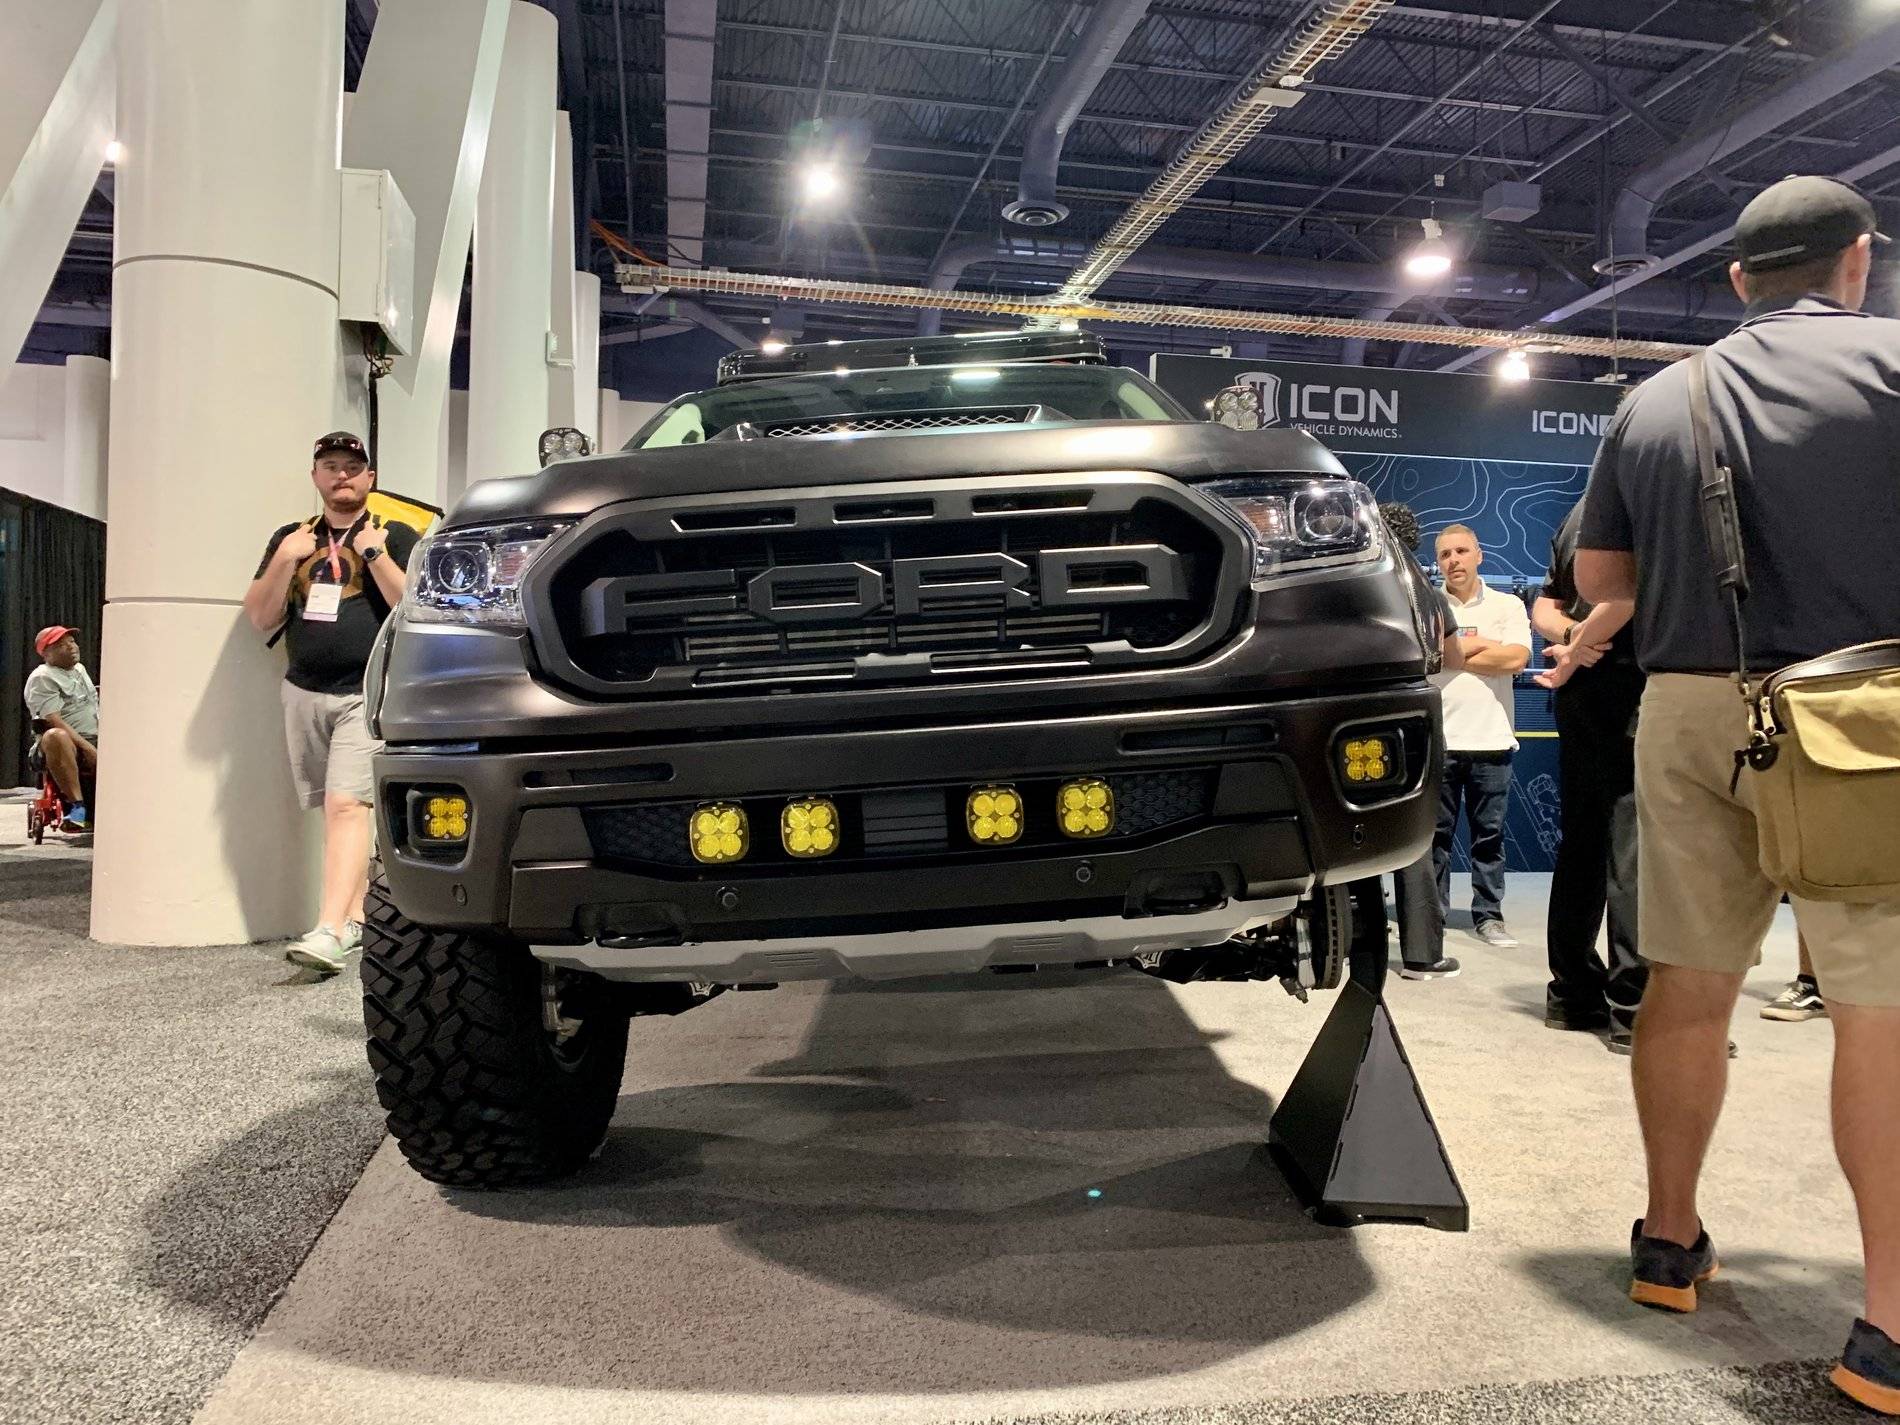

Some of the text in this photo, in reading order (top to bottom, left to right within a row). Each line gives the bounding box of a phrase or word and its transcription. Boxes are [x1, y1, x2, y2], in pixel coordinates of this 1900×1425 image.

[1290, 383, 1398, 424] ICON
[1532, 410, 1598, 436] ICON
[578, 543, 1188, 637] FORD
